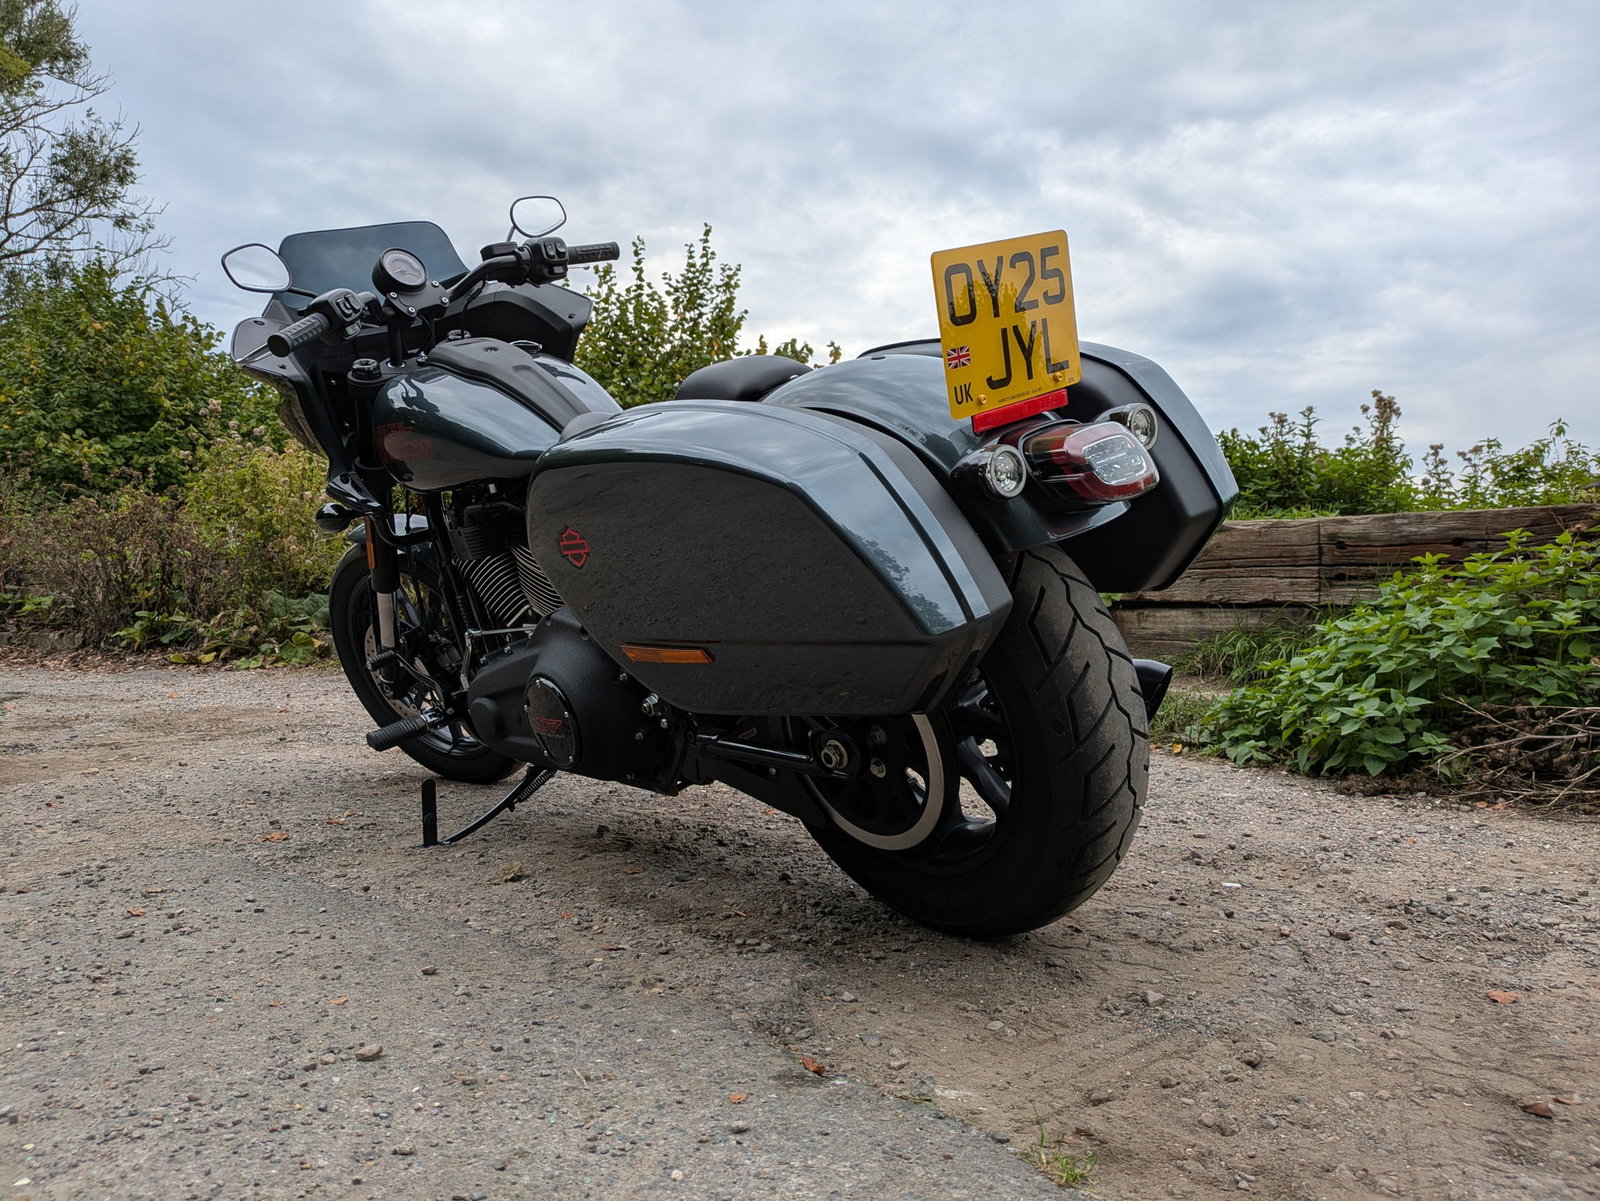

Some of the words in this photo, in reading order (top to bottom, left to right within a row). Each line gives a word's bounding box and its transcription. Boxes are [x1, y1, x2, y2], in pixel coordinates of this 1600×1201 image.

[944, 245, 1066, 327] OY25
[986, 318, 1070, 390] JYL
[953, 382, 974, 405] UK
